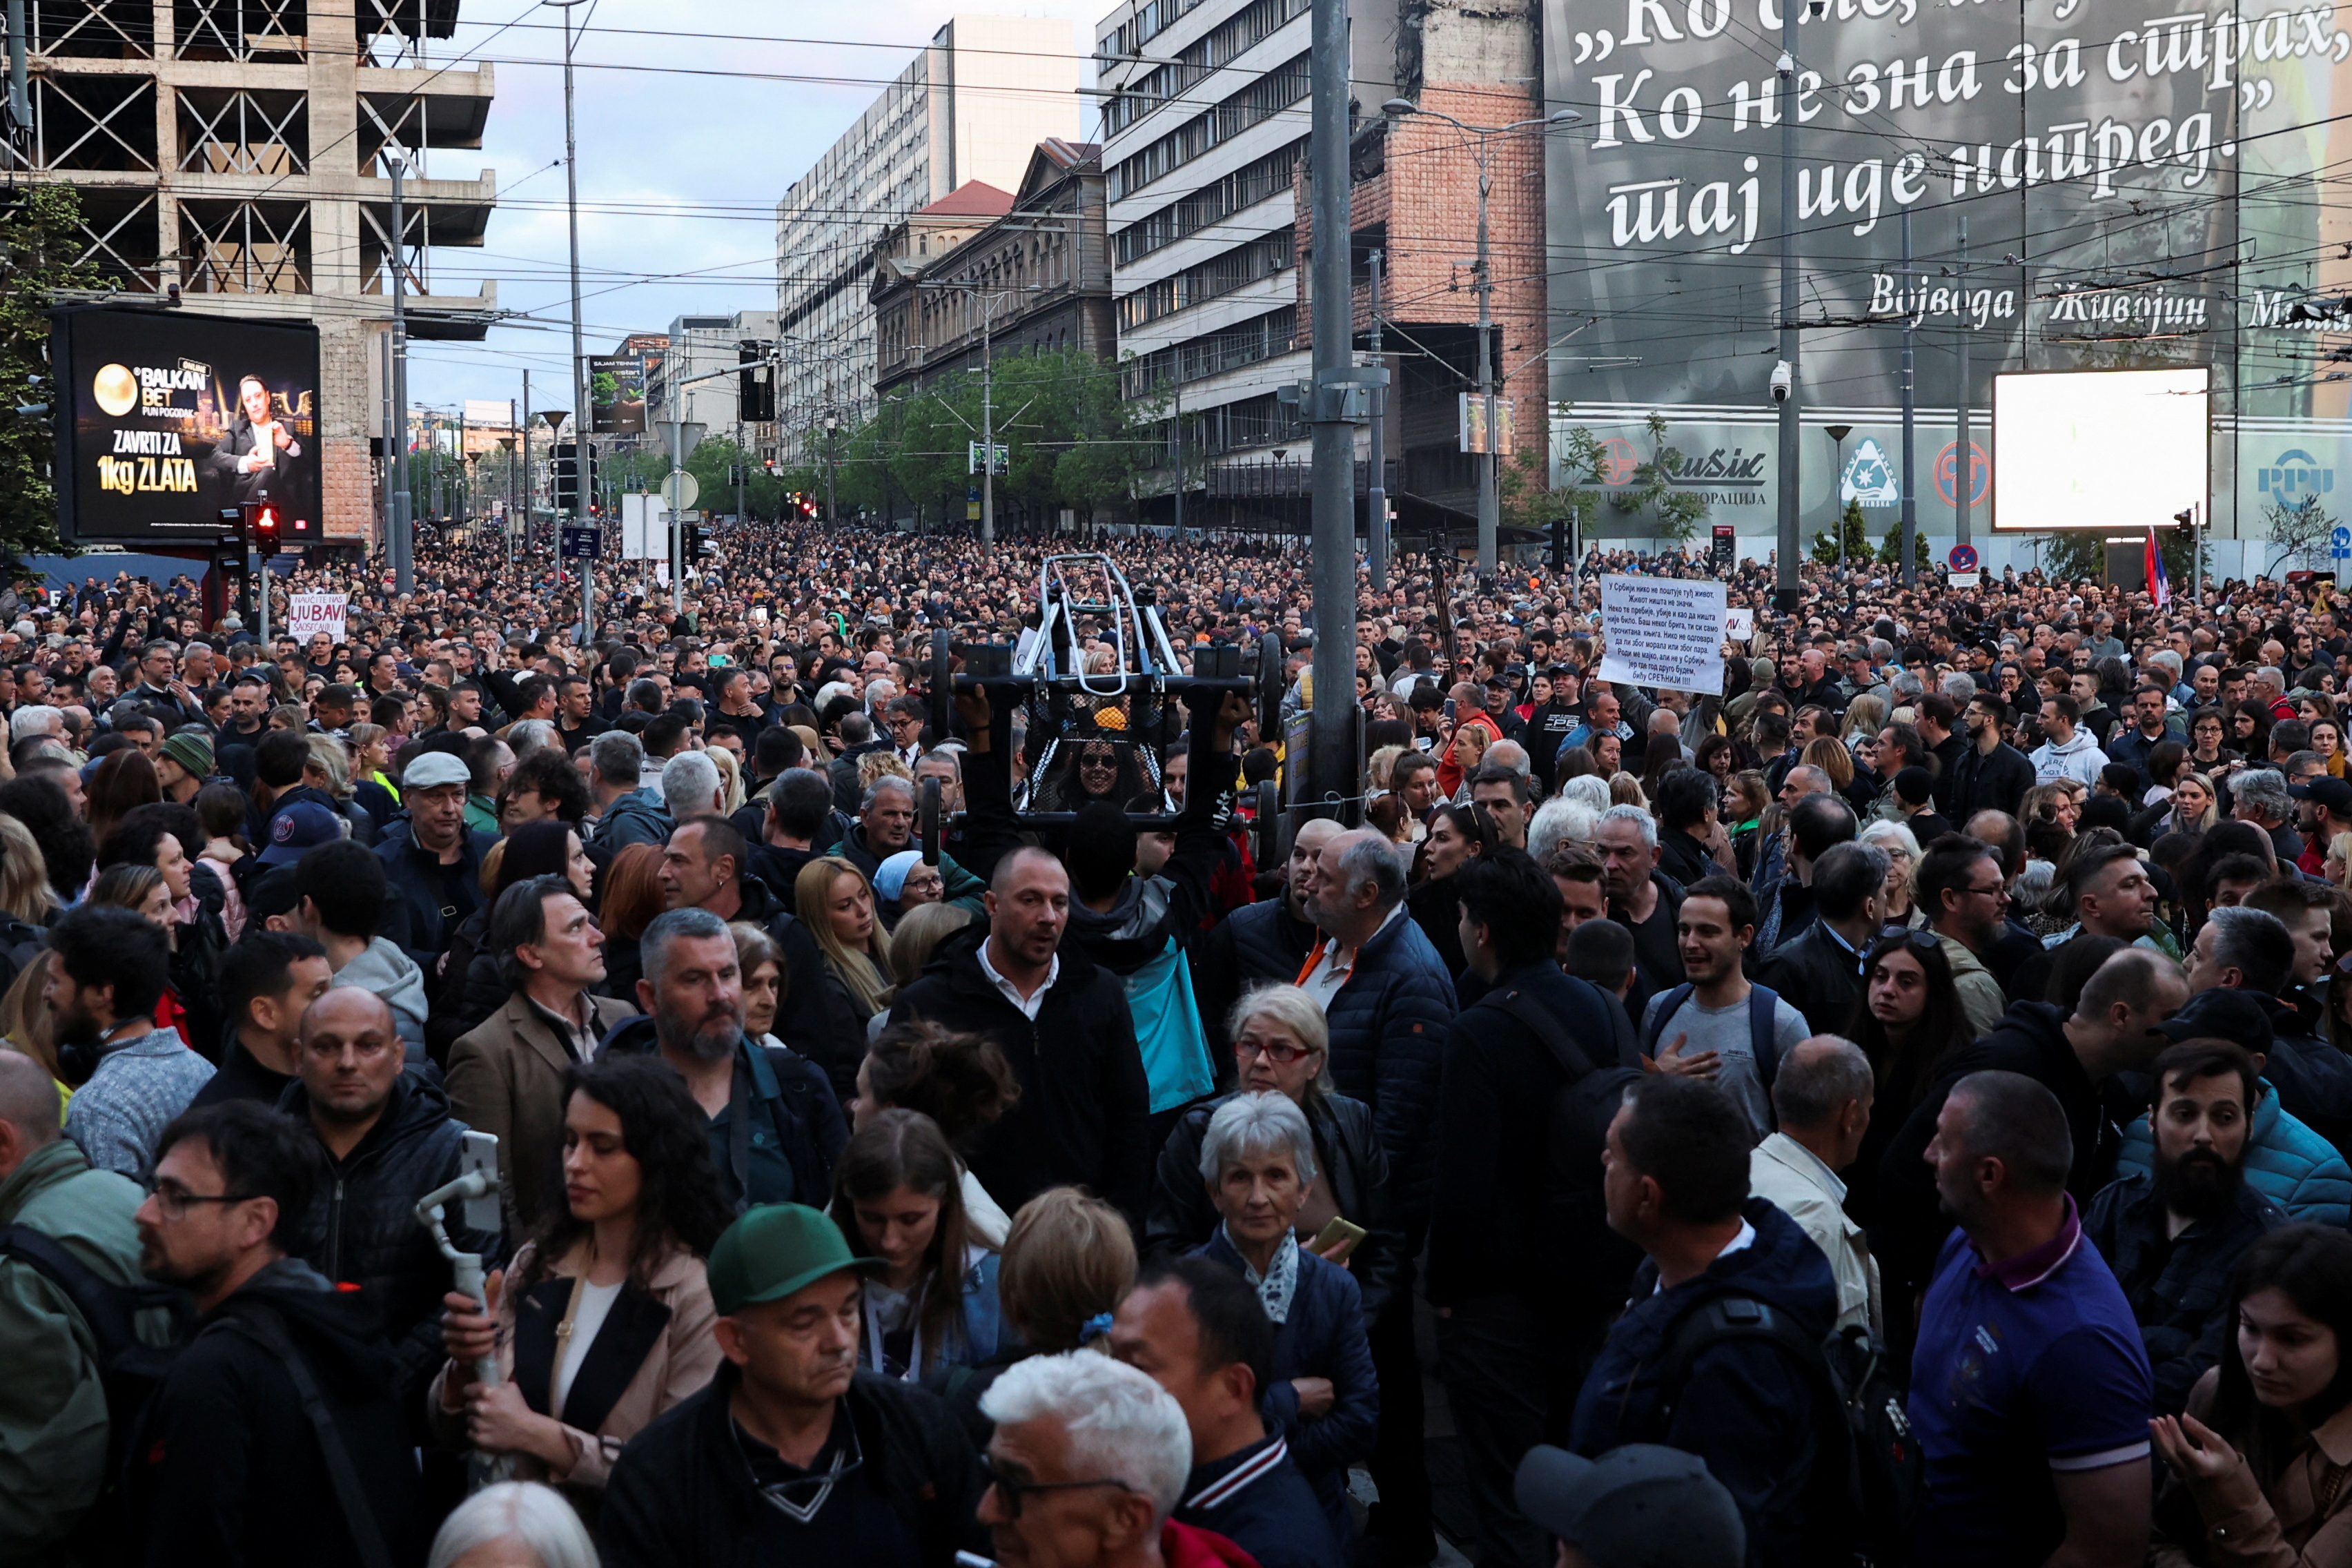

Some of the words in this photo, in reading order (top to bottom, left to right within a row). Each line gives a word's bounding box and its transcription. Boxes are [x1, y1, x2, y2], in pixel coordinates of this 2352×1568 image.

[1591, 68, 1703, 150] Ко
[1727, 70, 1824, 133] не
[1845, 50, 1983, 115] зна
[2003, 38, 2086, 95] за
[2106, 6, 2351, 91] страх,
[1605, 155, 1760, 255] тај
[1798, 153, 1926, 237] иде
[183, 360, 207, 374] ONLINE
[141, 367, 206, 391] BALKAN
[142, 387, 174, 407] BET
[142, 406, 159, 417] PUN
[159, 407, 195, 418] POGODAK
[113, 429, 161, 454] ZAVRTI
[162, 432, 182, 455] ZA
[97, 455, 135, 495] 1kg
[137, 457, 198, 492] ZLATA
[1614, 582, 1635, 594] Србији
[1659, 587, 1682, 597] поштује
[1683, 589, 1694, 598] туђ
[1629, 594, 1648, 603] Живот
[1676, 600, 1694, 608] значи.
[291, 605, 346, 623] LJUBAVI
[1608, 604, 1623, 612] Неко
[1631, 606, 1655, 616] пребије,
[1656, 608, 1672, 618] убије
[1607, 615, 1620, 625] није
[1620, 616, 1637, 625] било.
[1638, 616, 1650, 625] Баш
[1668, 620, 1686, 630] брига,
[1703, 625, 1718, 633] само
[1611, 627, 1641, 636] прочитана
[1663, 631, 1678, 639] Нико
[1687, 634, 1714, 645] одговара
[1632, 638, 1645, 647] због
[1645, 641, 1667, 650] морала
[1680, 643, 1693, 652] због
[1694, 646, 1709, 655] пара.
[1618, 647, 1632, 657] Роди
[1642, 651, 1658, 661] мајко,
[1679, 656, 1683, 664] у
[1684, 654, 1707, 666] Србији,
[1629, 659, 1638, 669] јер
[1658, 665, 1675, 674] друго
[1676, 665, 1696, 676] будем,
[1632, 671, 1647, 681] бићу
